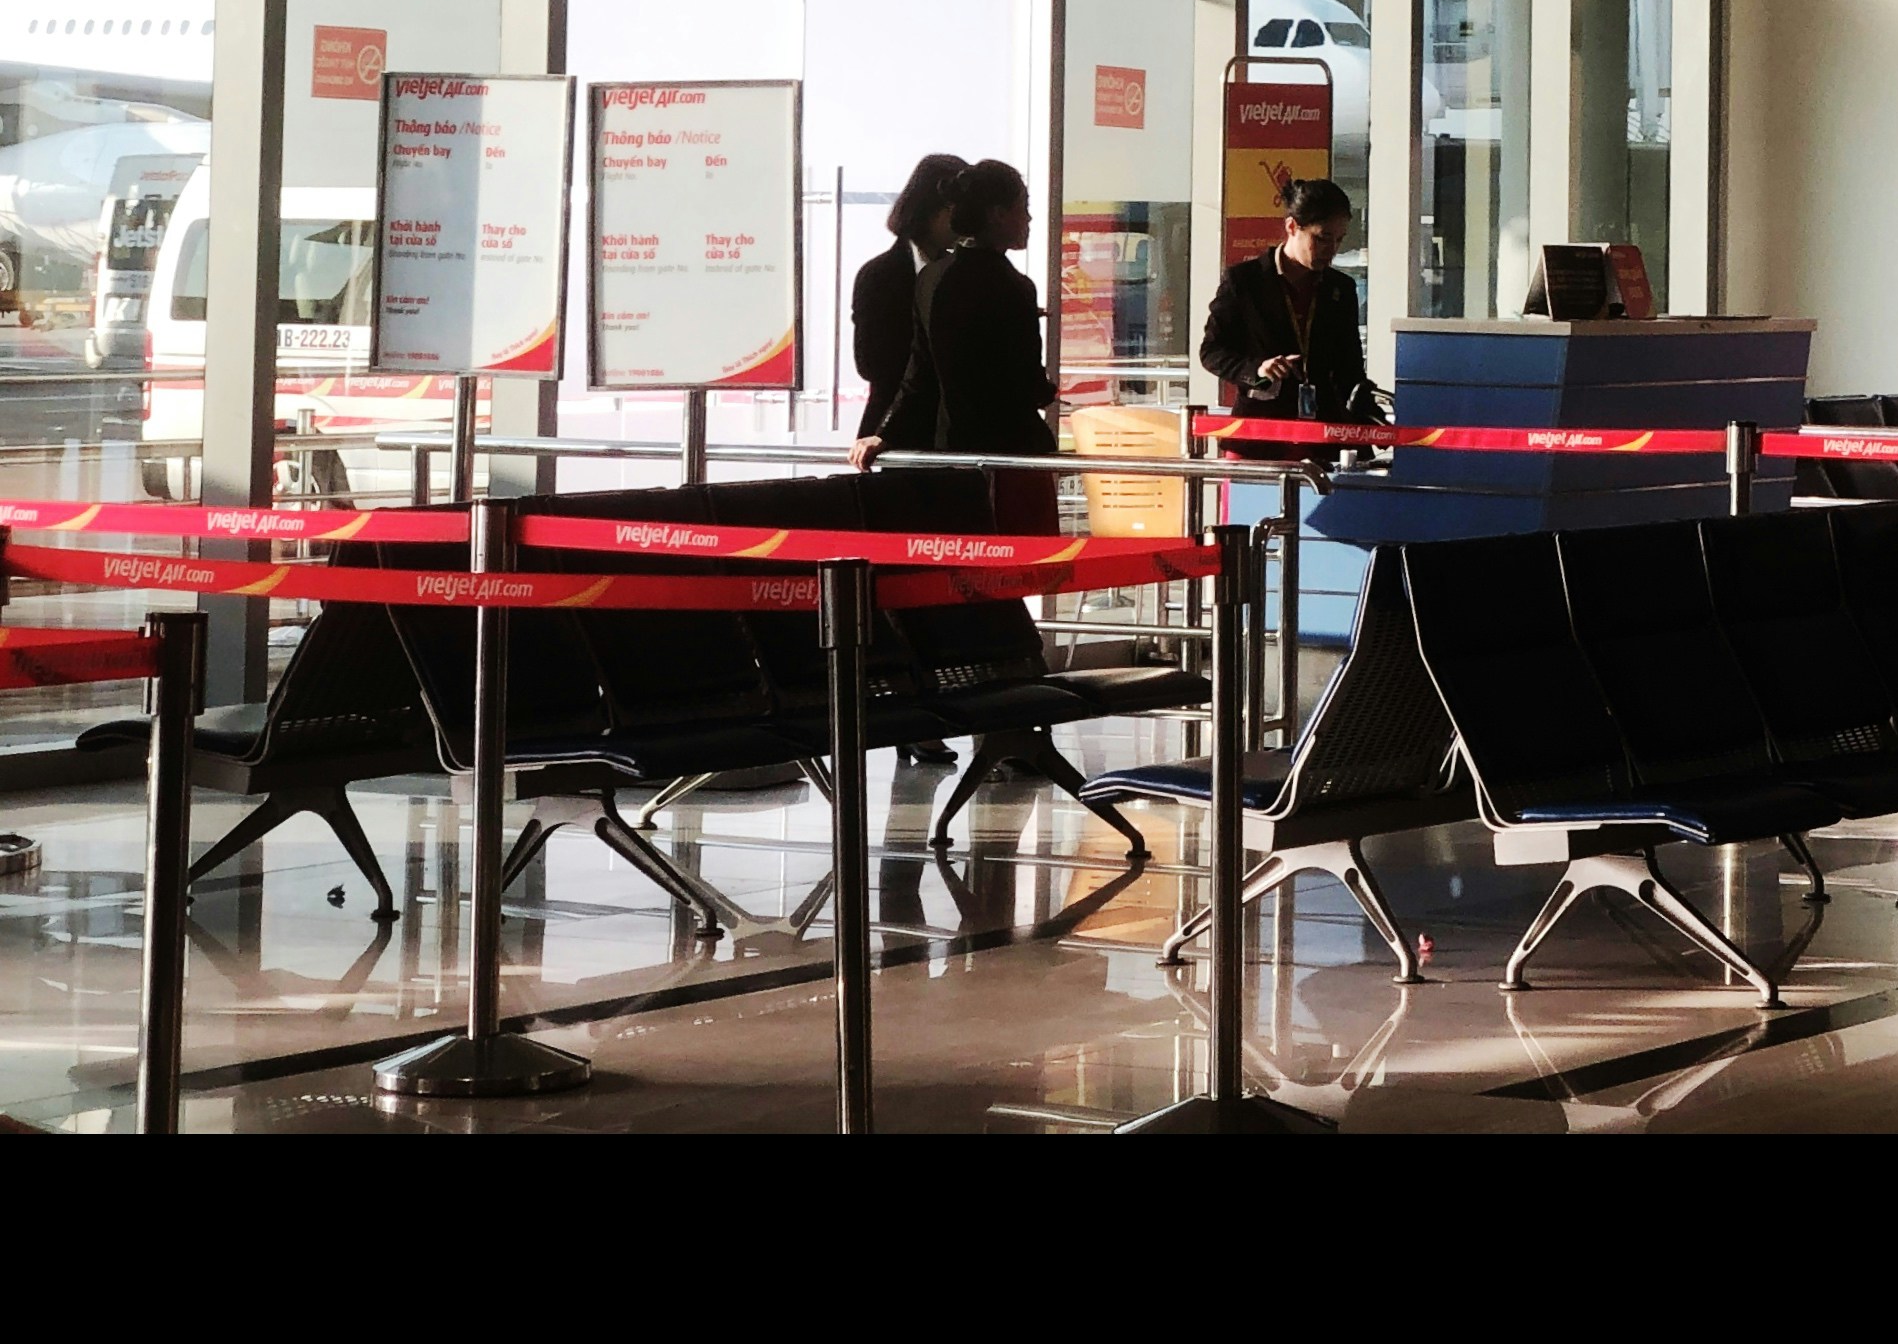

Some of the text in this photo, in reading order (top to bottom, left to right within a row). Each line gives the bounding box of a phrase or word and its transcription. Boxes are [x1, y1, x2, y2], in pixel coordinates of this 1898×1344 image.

[395, 119, 432, 137] Thông
[435, 120, 456, 135] báo
[604, 131, 644, 148] Thông
[647, 130, 672, 145] báo
[433, 145, 452, 160] bay
[705, 153, 728, 167] Đến
[647, 156, 667, 170] bay
[483, 223, 526, 238] Thay cho
[630, 233, 659, 246] hành
[705, 233, 755, 248] Thay cho
